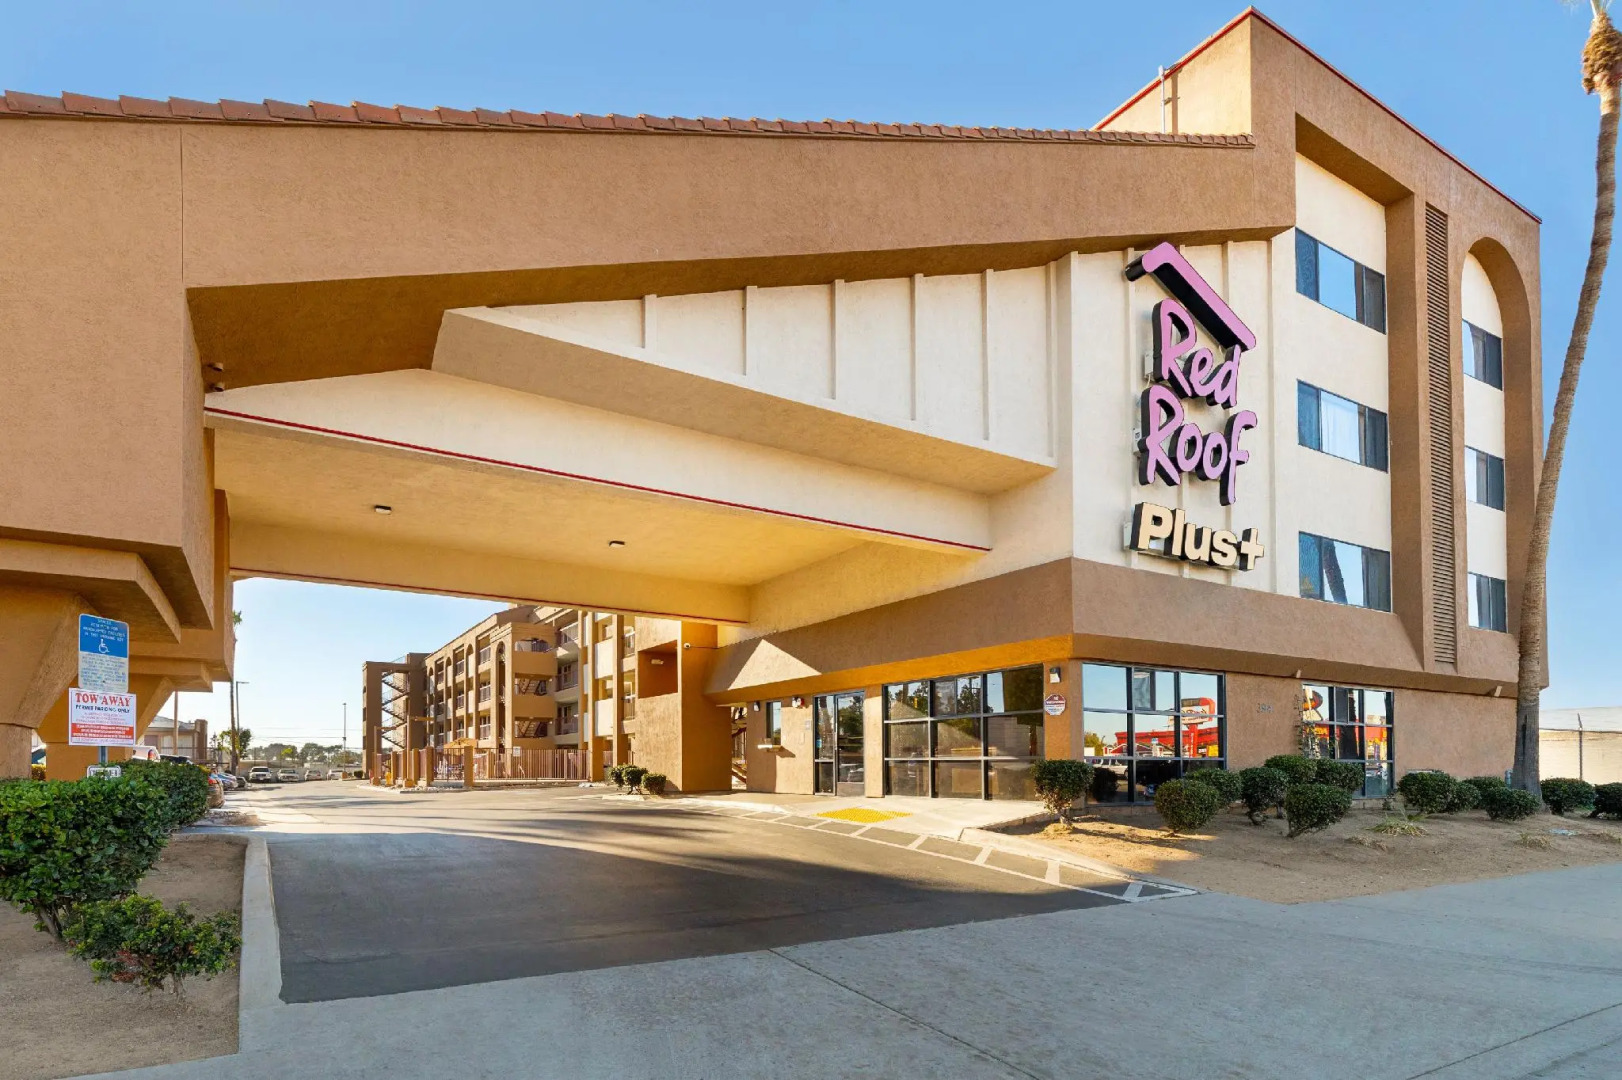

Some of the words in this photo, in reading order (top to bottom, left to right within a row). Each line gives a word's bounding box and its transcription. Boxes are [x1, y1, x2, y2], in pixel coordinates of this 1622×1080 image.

[1153, 298, 1241, 409] Red
[1140, 384, 1257, 506] Roof
[75, 693, 98, 704] TOW
[101, 695, 131, 707] AWAY
